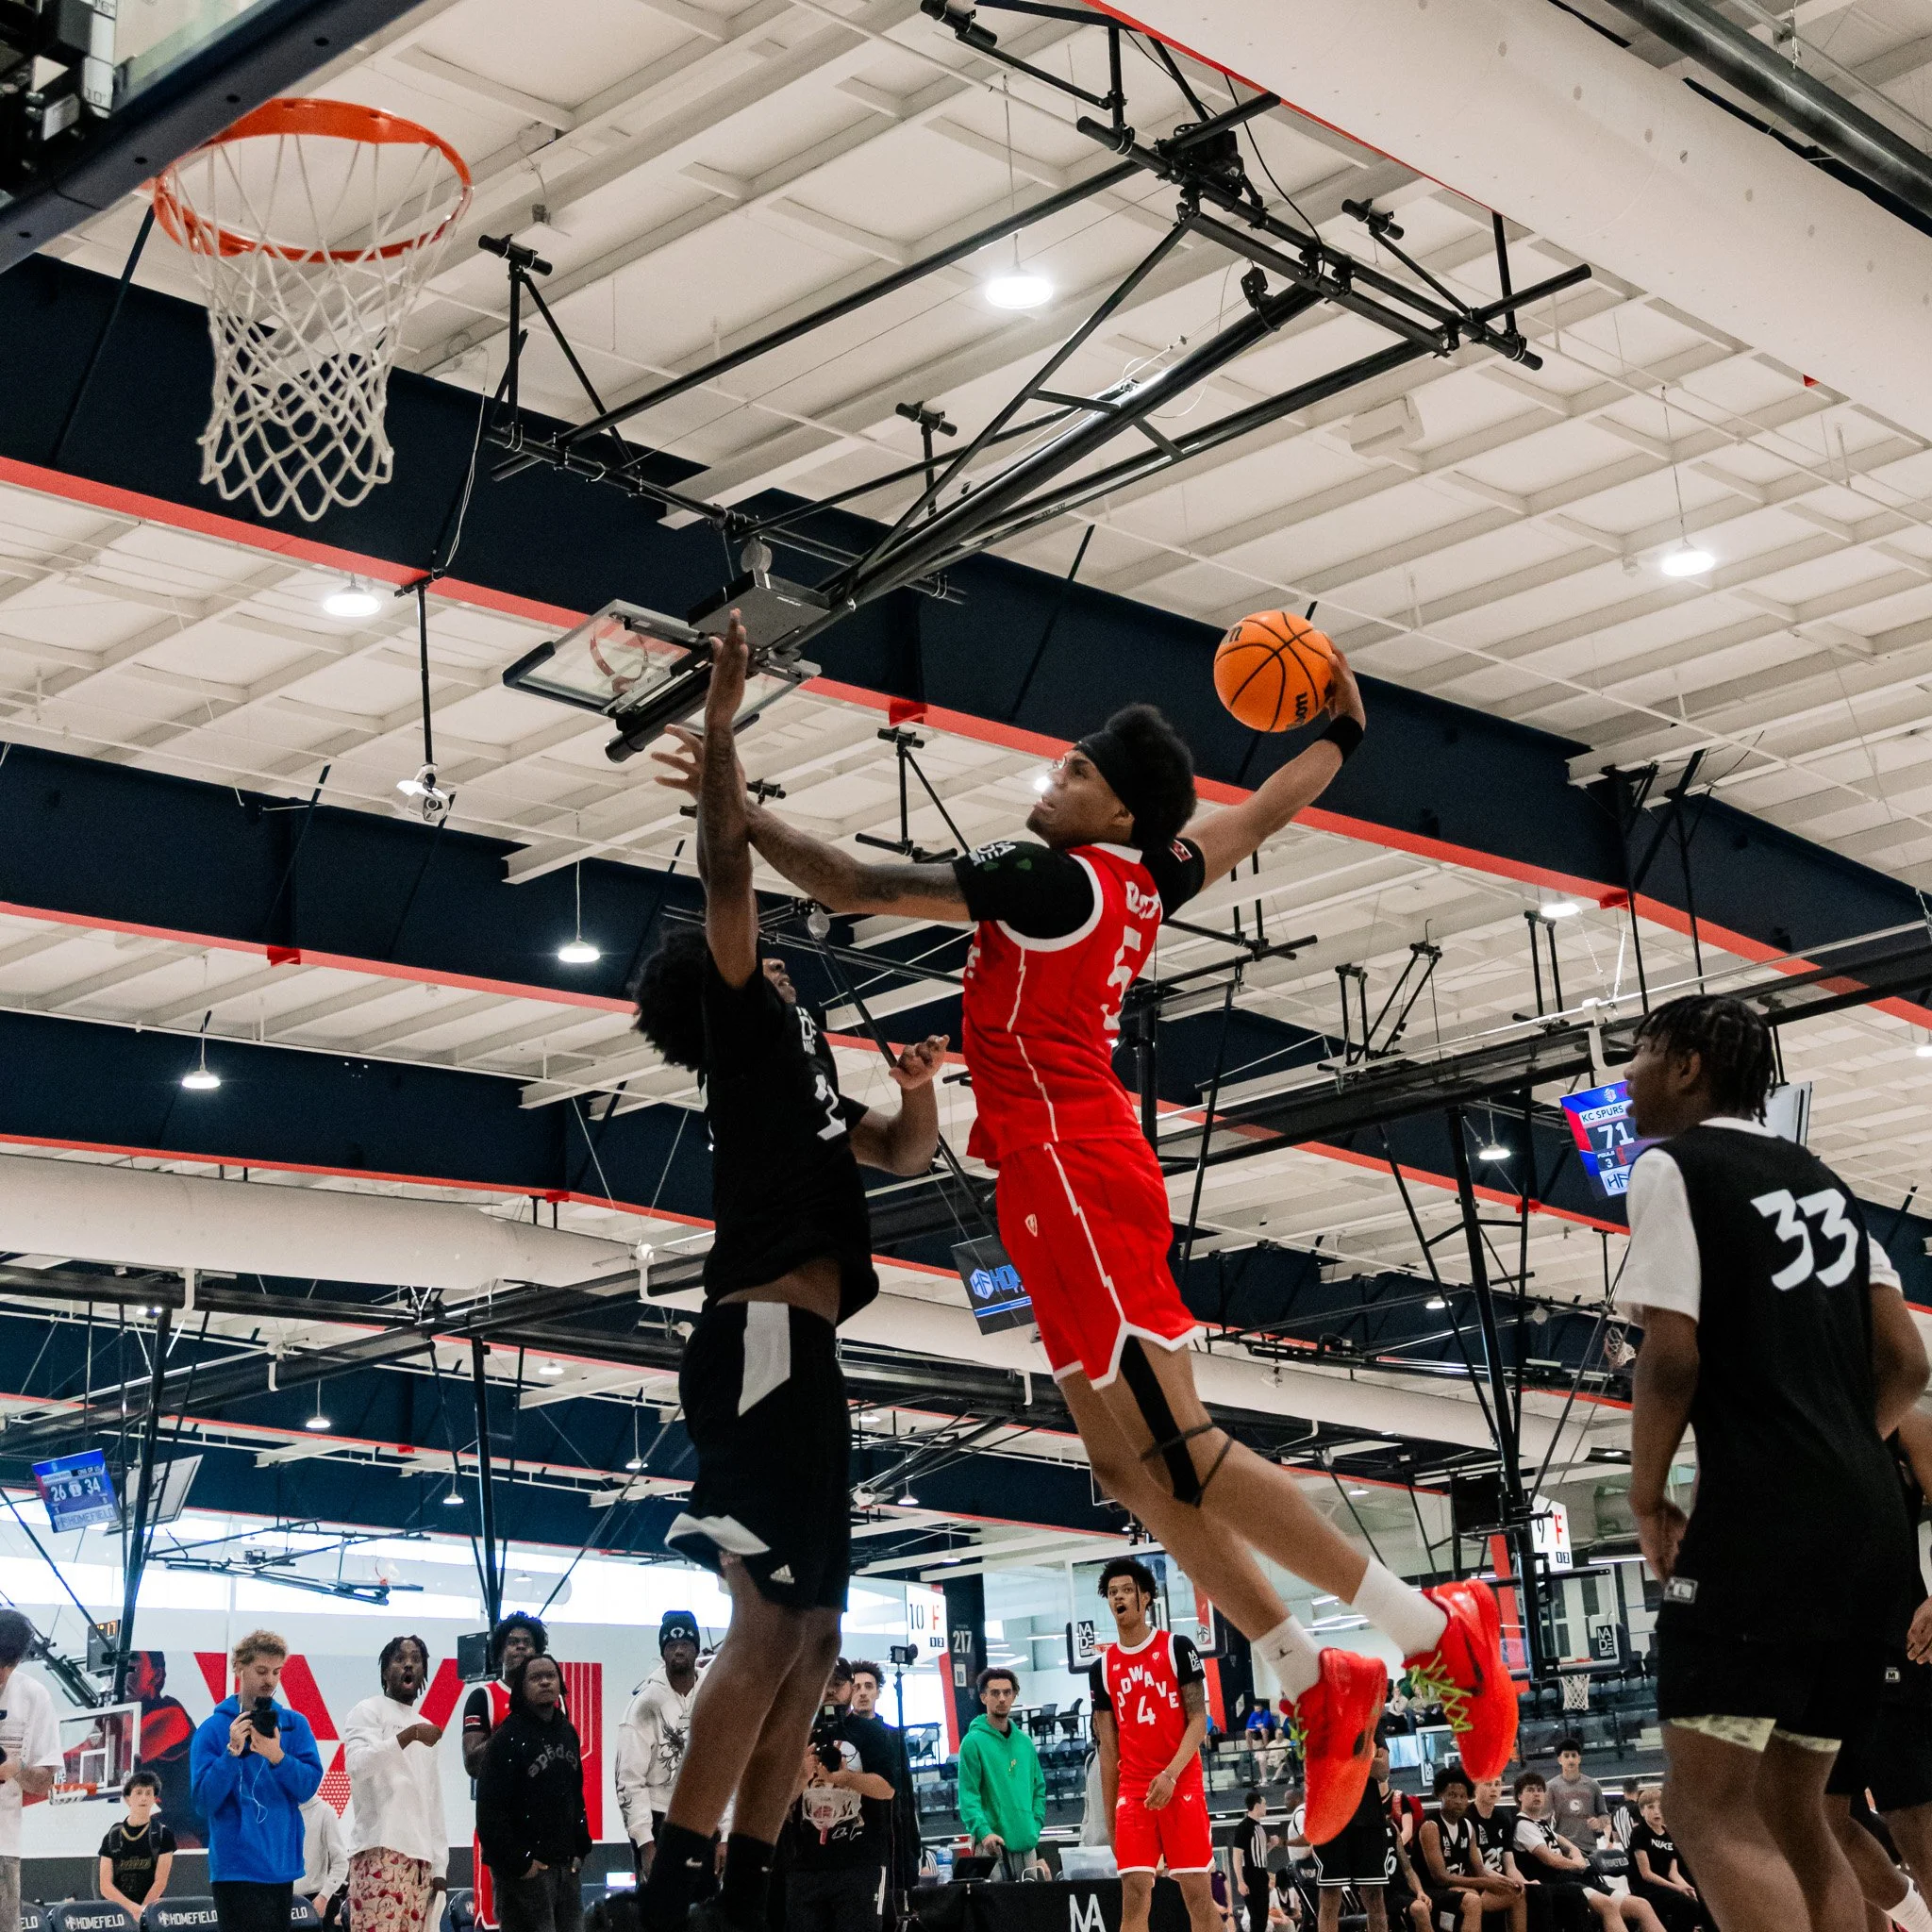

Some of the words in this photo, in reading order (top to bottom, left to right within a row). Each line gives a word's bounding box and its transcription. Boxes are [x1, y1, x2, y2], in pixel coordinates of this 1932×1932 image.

[1581, 1112, 1593, 1123] KC
[1595, 1106, 1624, 1119] SPURS
[1597, 1121, 1635, 1149] 71
[1605, 1158, 1613, 1168] 3
[1750, 1188, 1858, 1291] 33
[50, 1484, 67, 1502] 26
[84, 1476, 101, 1495] 34
[1555, 1514, 1563, 1544] F
[909, 1603, 924, 1630] 10
[932, 1604, 940, 1630] F
[953, 1630, 972, 1653] 217
[1137, 1695, 1157, 1725] 4
[1651, 1839, 1674, 1851] NIKE
[75, 1913, 125, 1930] HOMEFIELD
[170, 1909, 218, 1924] HOMEFIELD
